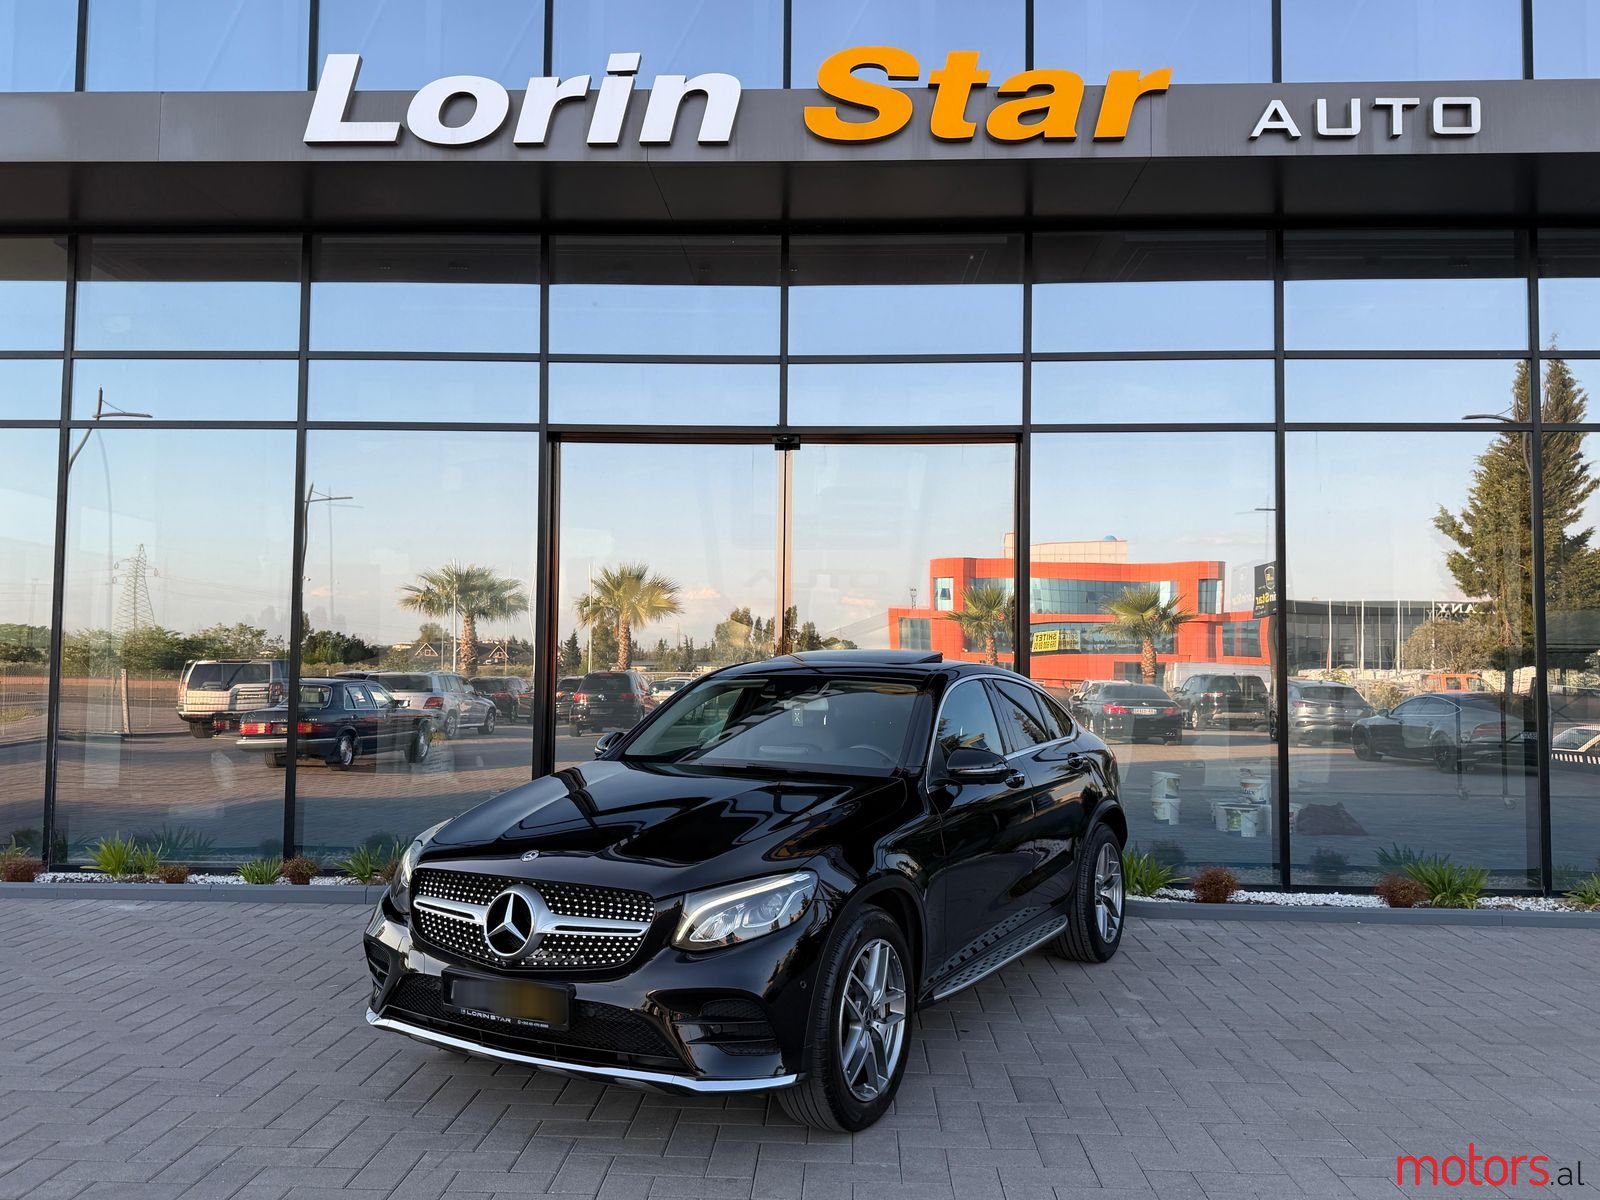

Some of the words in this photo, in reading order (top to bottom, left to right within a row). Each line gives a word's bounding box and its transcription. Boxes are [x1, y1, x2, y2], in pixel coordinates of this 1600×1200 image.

[303, 53, 742, 146] Lorin
[804, 45, 1173, 144] Star
[1250, 95, 1481, 140] AUTO
[466, 1010, 490, 1019] LORIN
[490, 1014, 512, 1023] STAR
